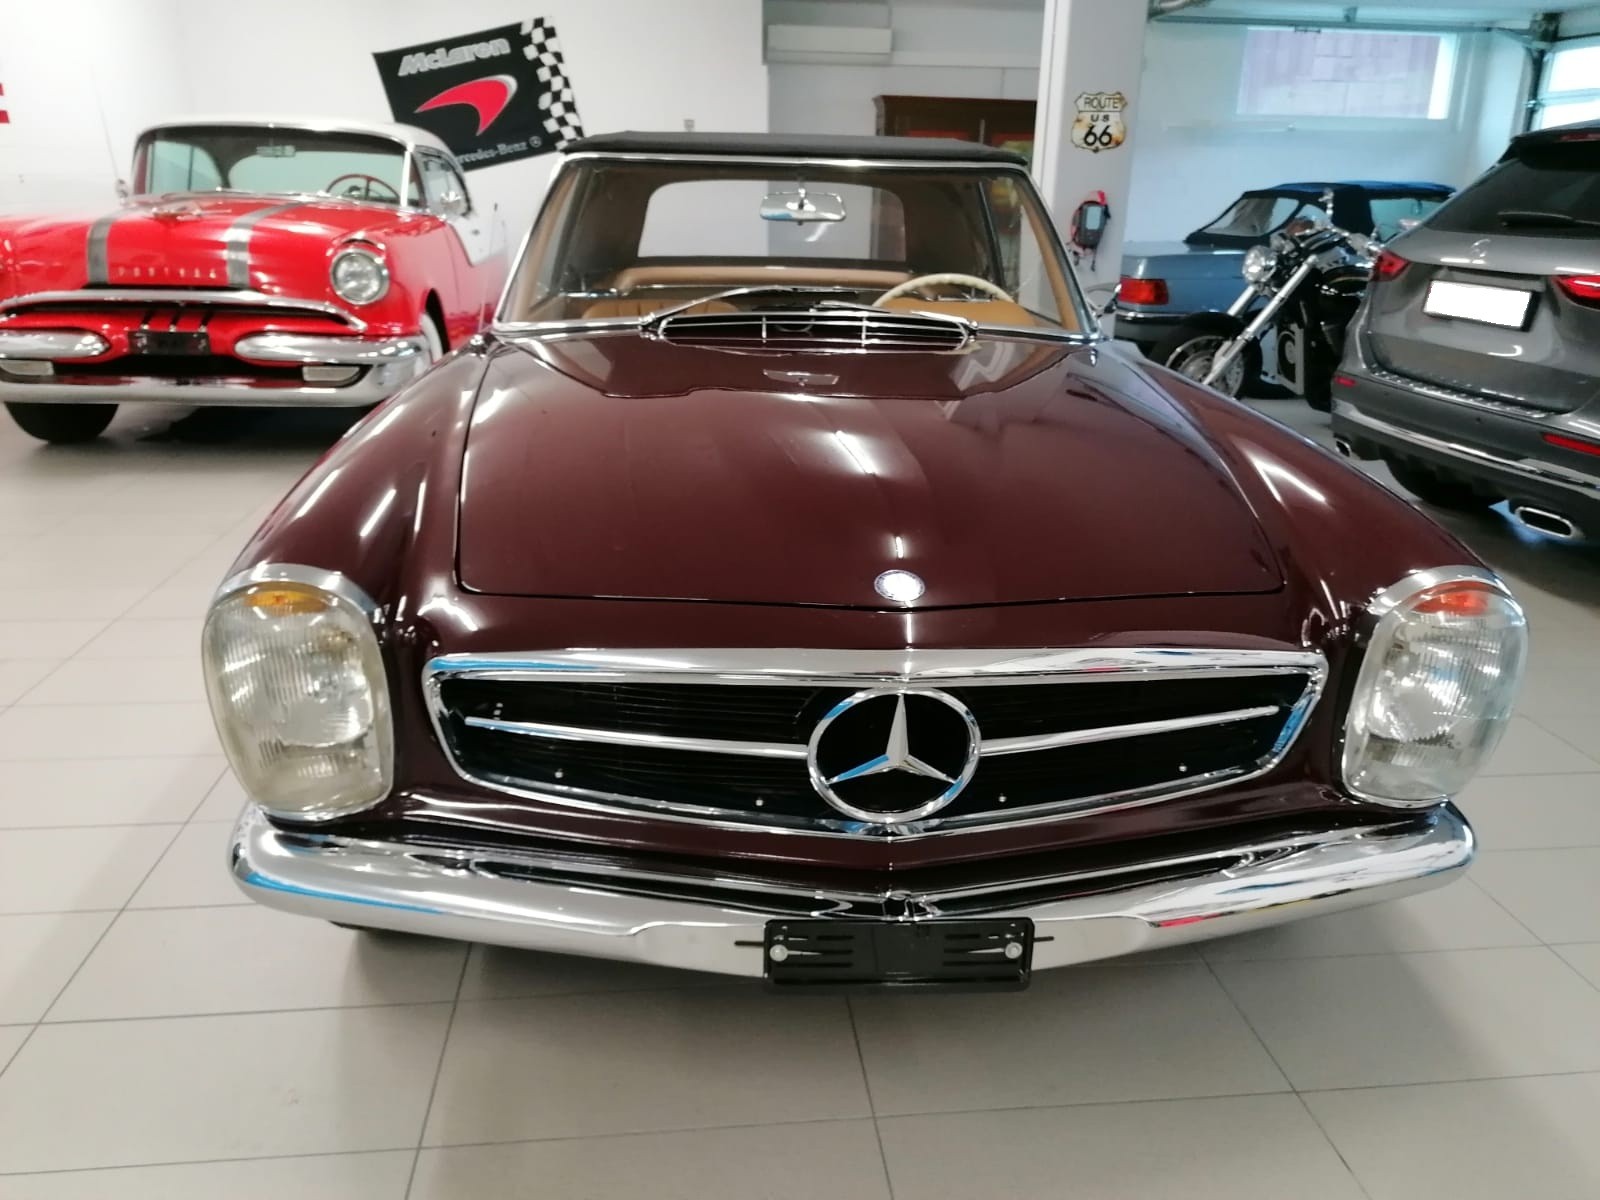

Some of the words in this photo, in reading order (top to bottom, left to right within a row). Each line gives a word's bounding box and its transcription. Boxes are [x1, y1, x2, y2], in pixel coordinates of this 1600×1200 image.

[398, 38, 511, 76] McLaren
[1084, 97, 1119, 109] ROUTE
[1084, 125, 1112, 146] 66
